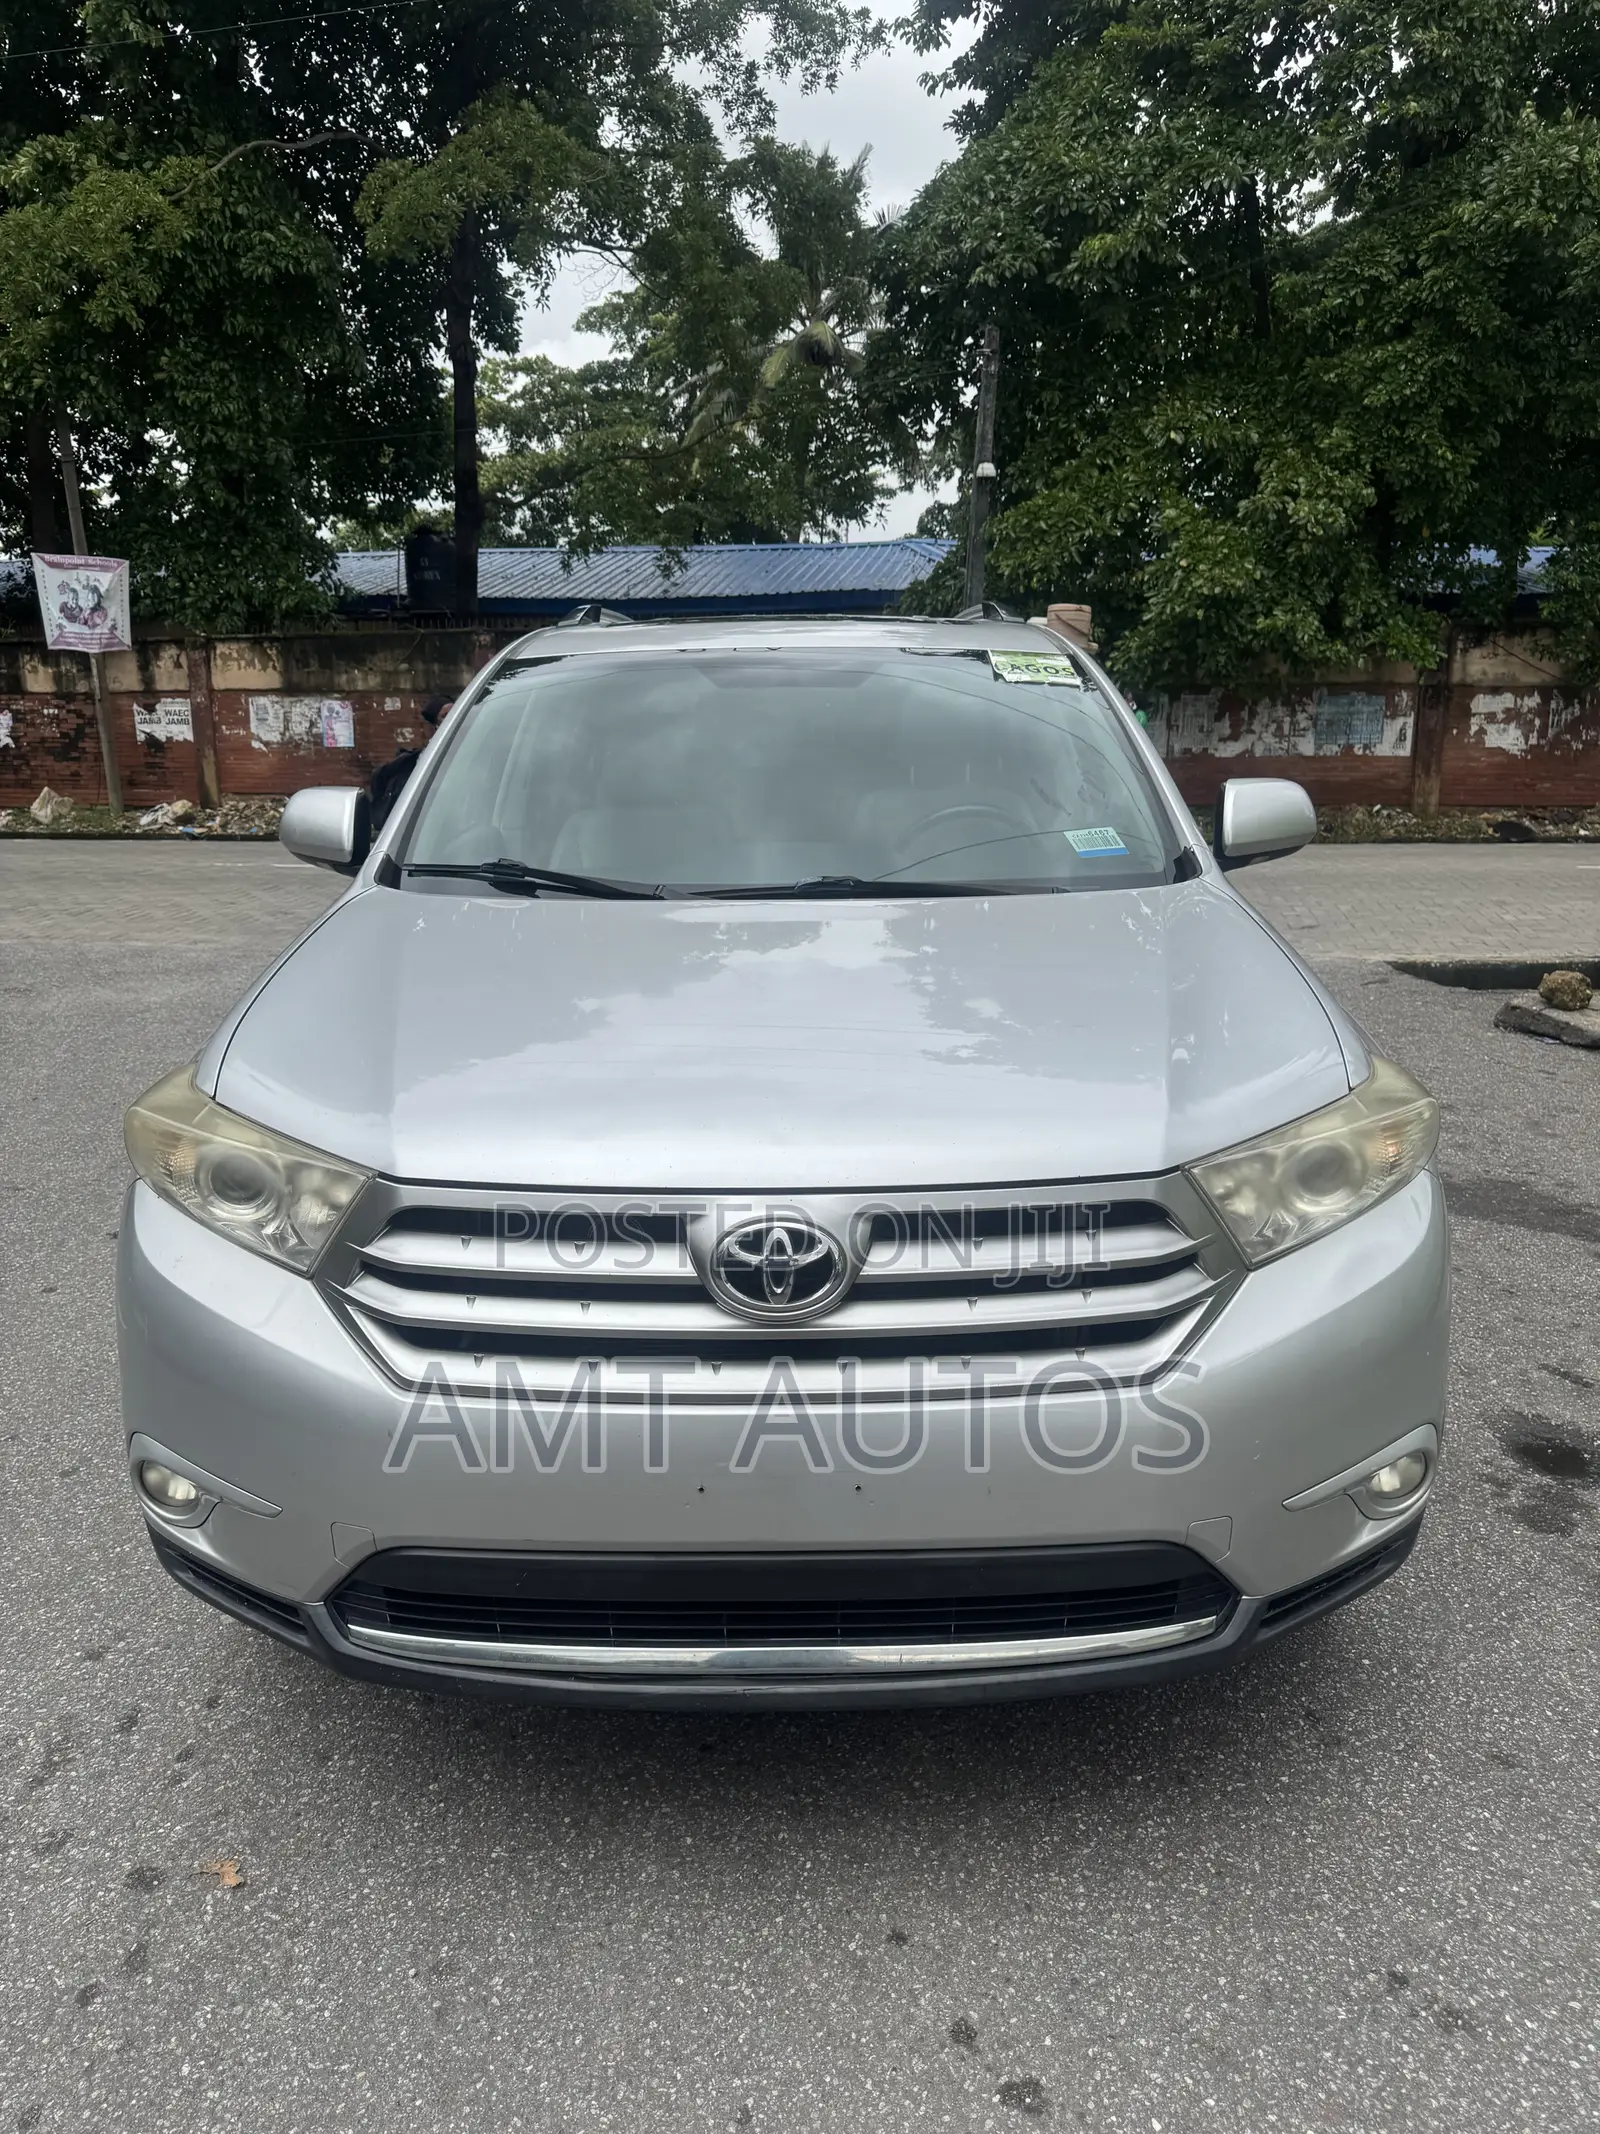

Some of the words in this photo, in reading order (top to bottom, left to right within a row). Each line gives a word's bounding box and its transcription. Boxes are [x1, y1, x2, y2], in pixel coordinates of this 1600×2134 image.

[44, 555, 85, 564] Brainpoint
[87, 558, 118, 567] Schools
[164, 708, 190, 717] WAEC
[165, 717, 190, 726] JAMB
